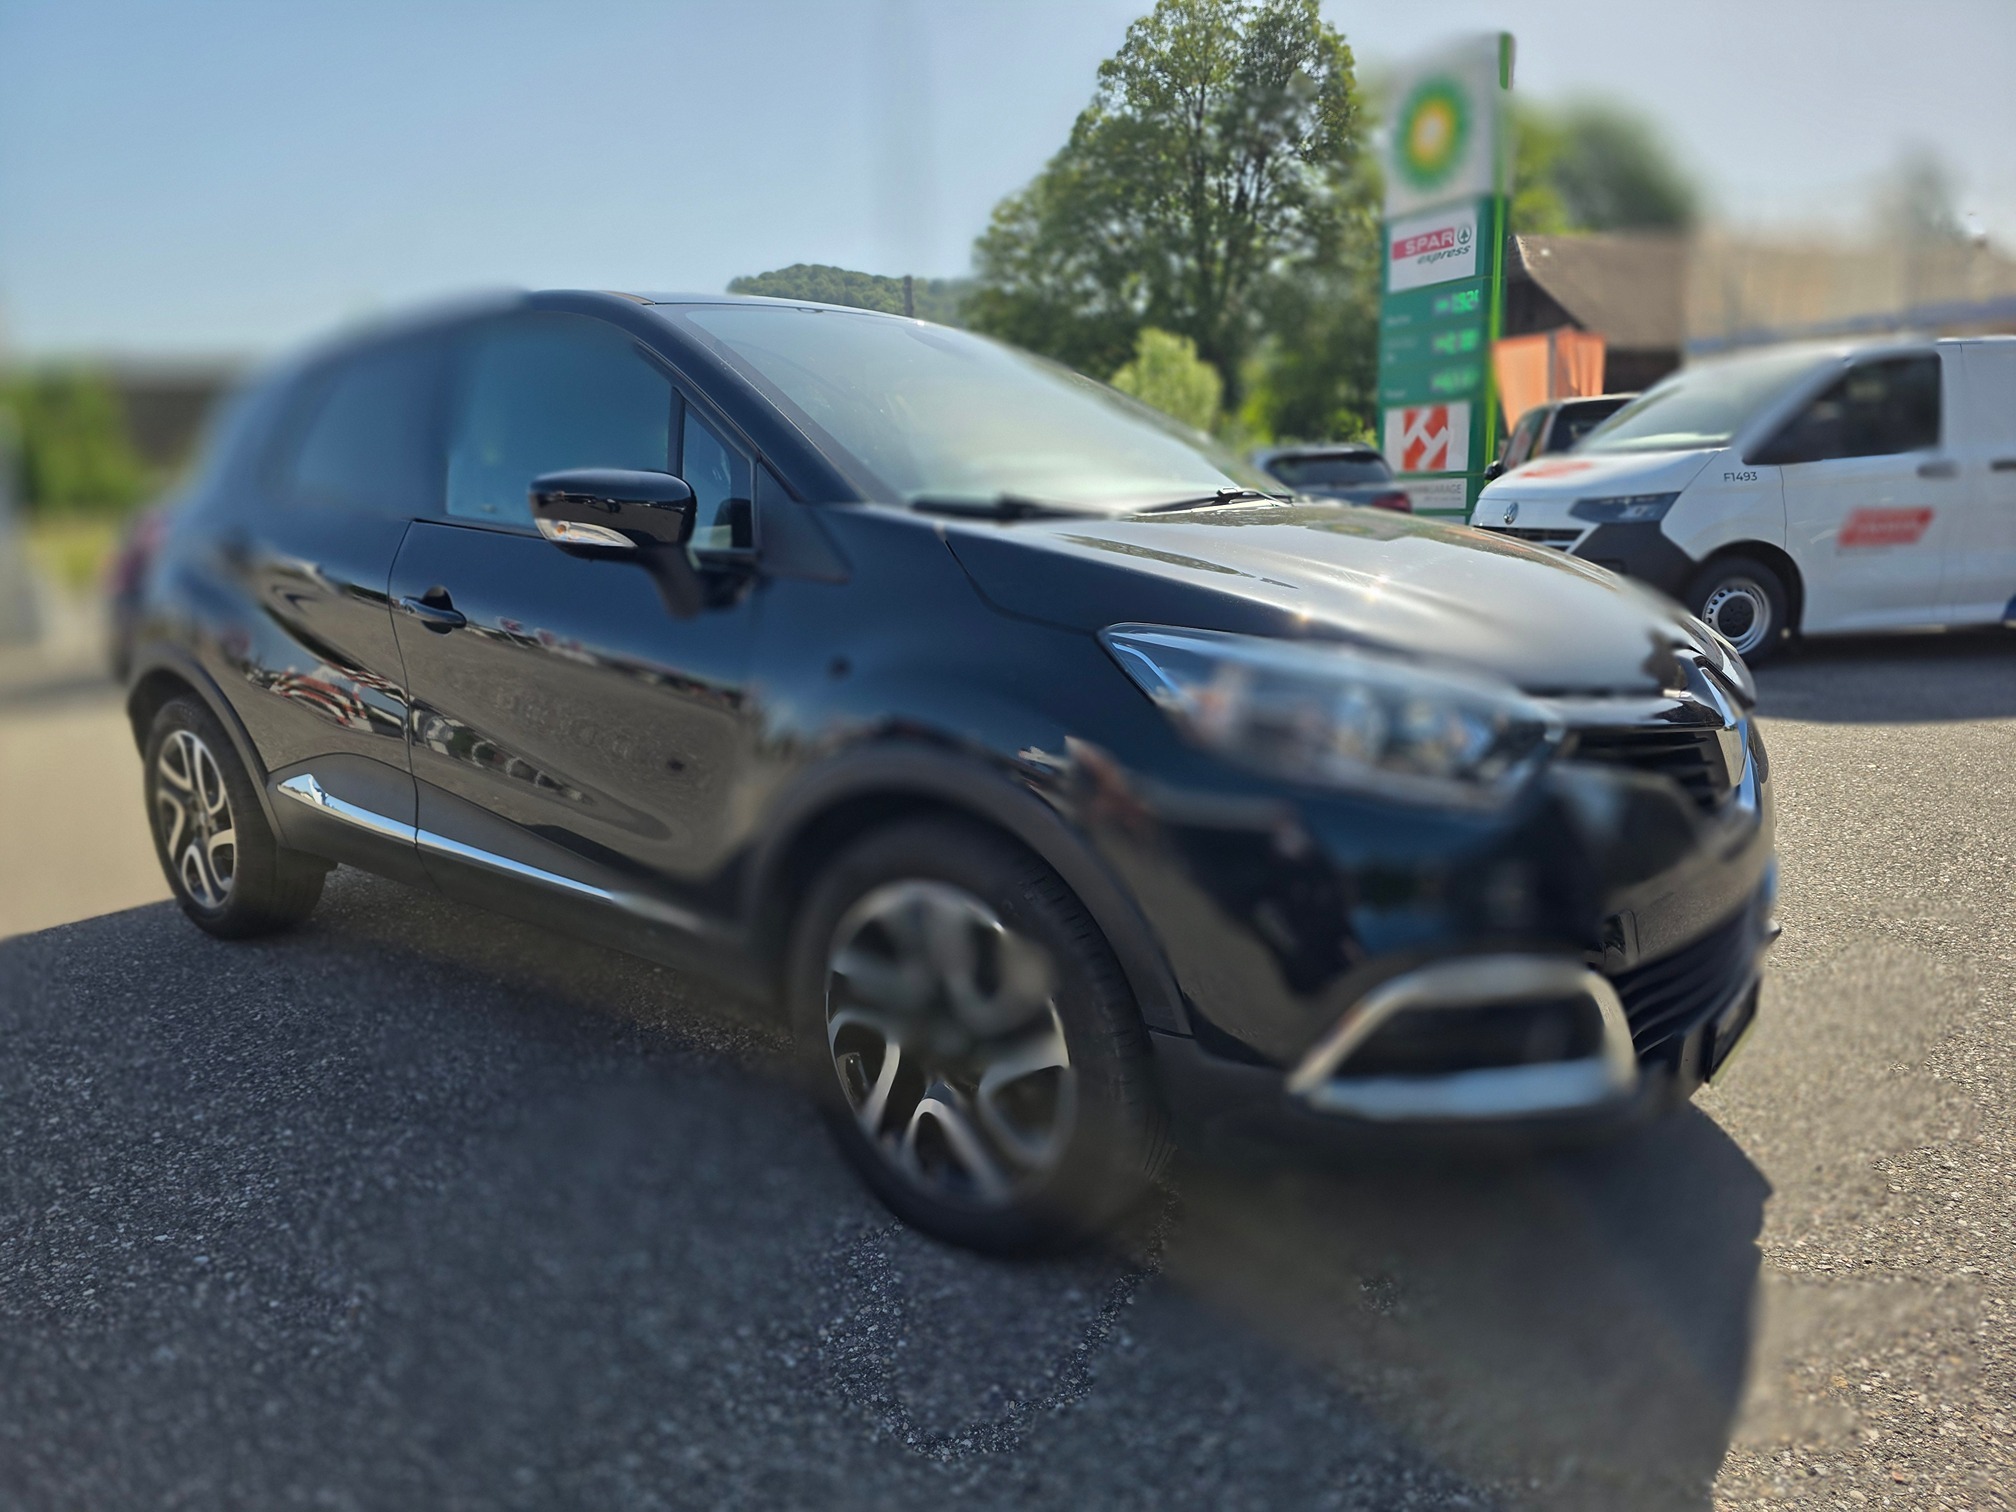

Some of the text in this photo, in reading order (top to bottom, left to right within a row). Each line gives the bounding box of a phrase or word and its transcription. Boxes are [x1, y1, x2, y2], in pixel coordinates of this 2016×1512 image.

[1405, 230, 1454, 255] SPAR
[1416, 245, 1471, 265] express
[1723, 471, 1758, 482] F1493
